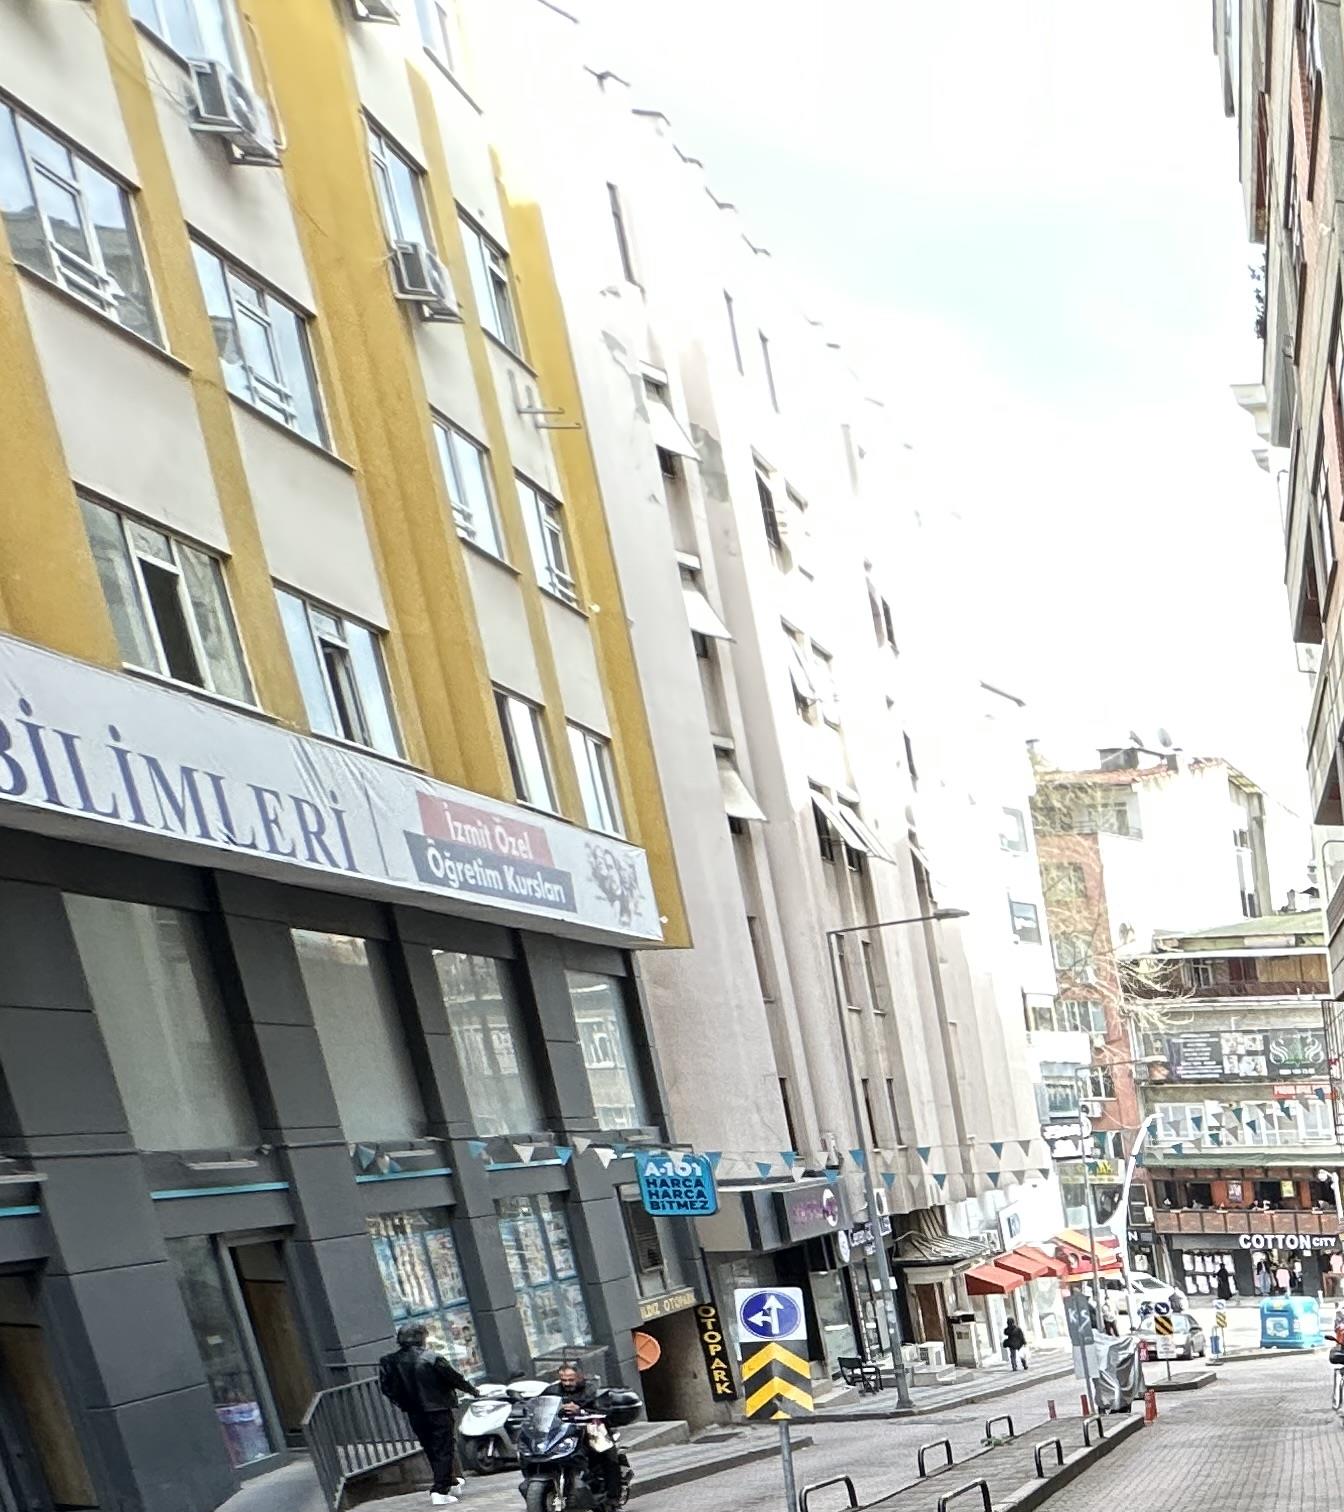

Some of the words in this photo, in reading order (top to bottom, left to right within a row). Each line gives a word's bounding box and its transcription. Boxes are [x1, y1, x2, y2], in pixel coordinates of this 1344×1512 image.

[444, 802, 491, 849] İzmit
[495, 818, 534, 860] Özel
[427, 839, 503, 891] Öğretim
[646, 1177, 705, 1189] HARCA
[648, 1189, 707, 1200] HARCA
[650, 1199, 710, 1212] BİTMEZ
[1238, 1234, 1312, 1250] COTTON
[700, 1305, 733, 1396] OTOPARK
